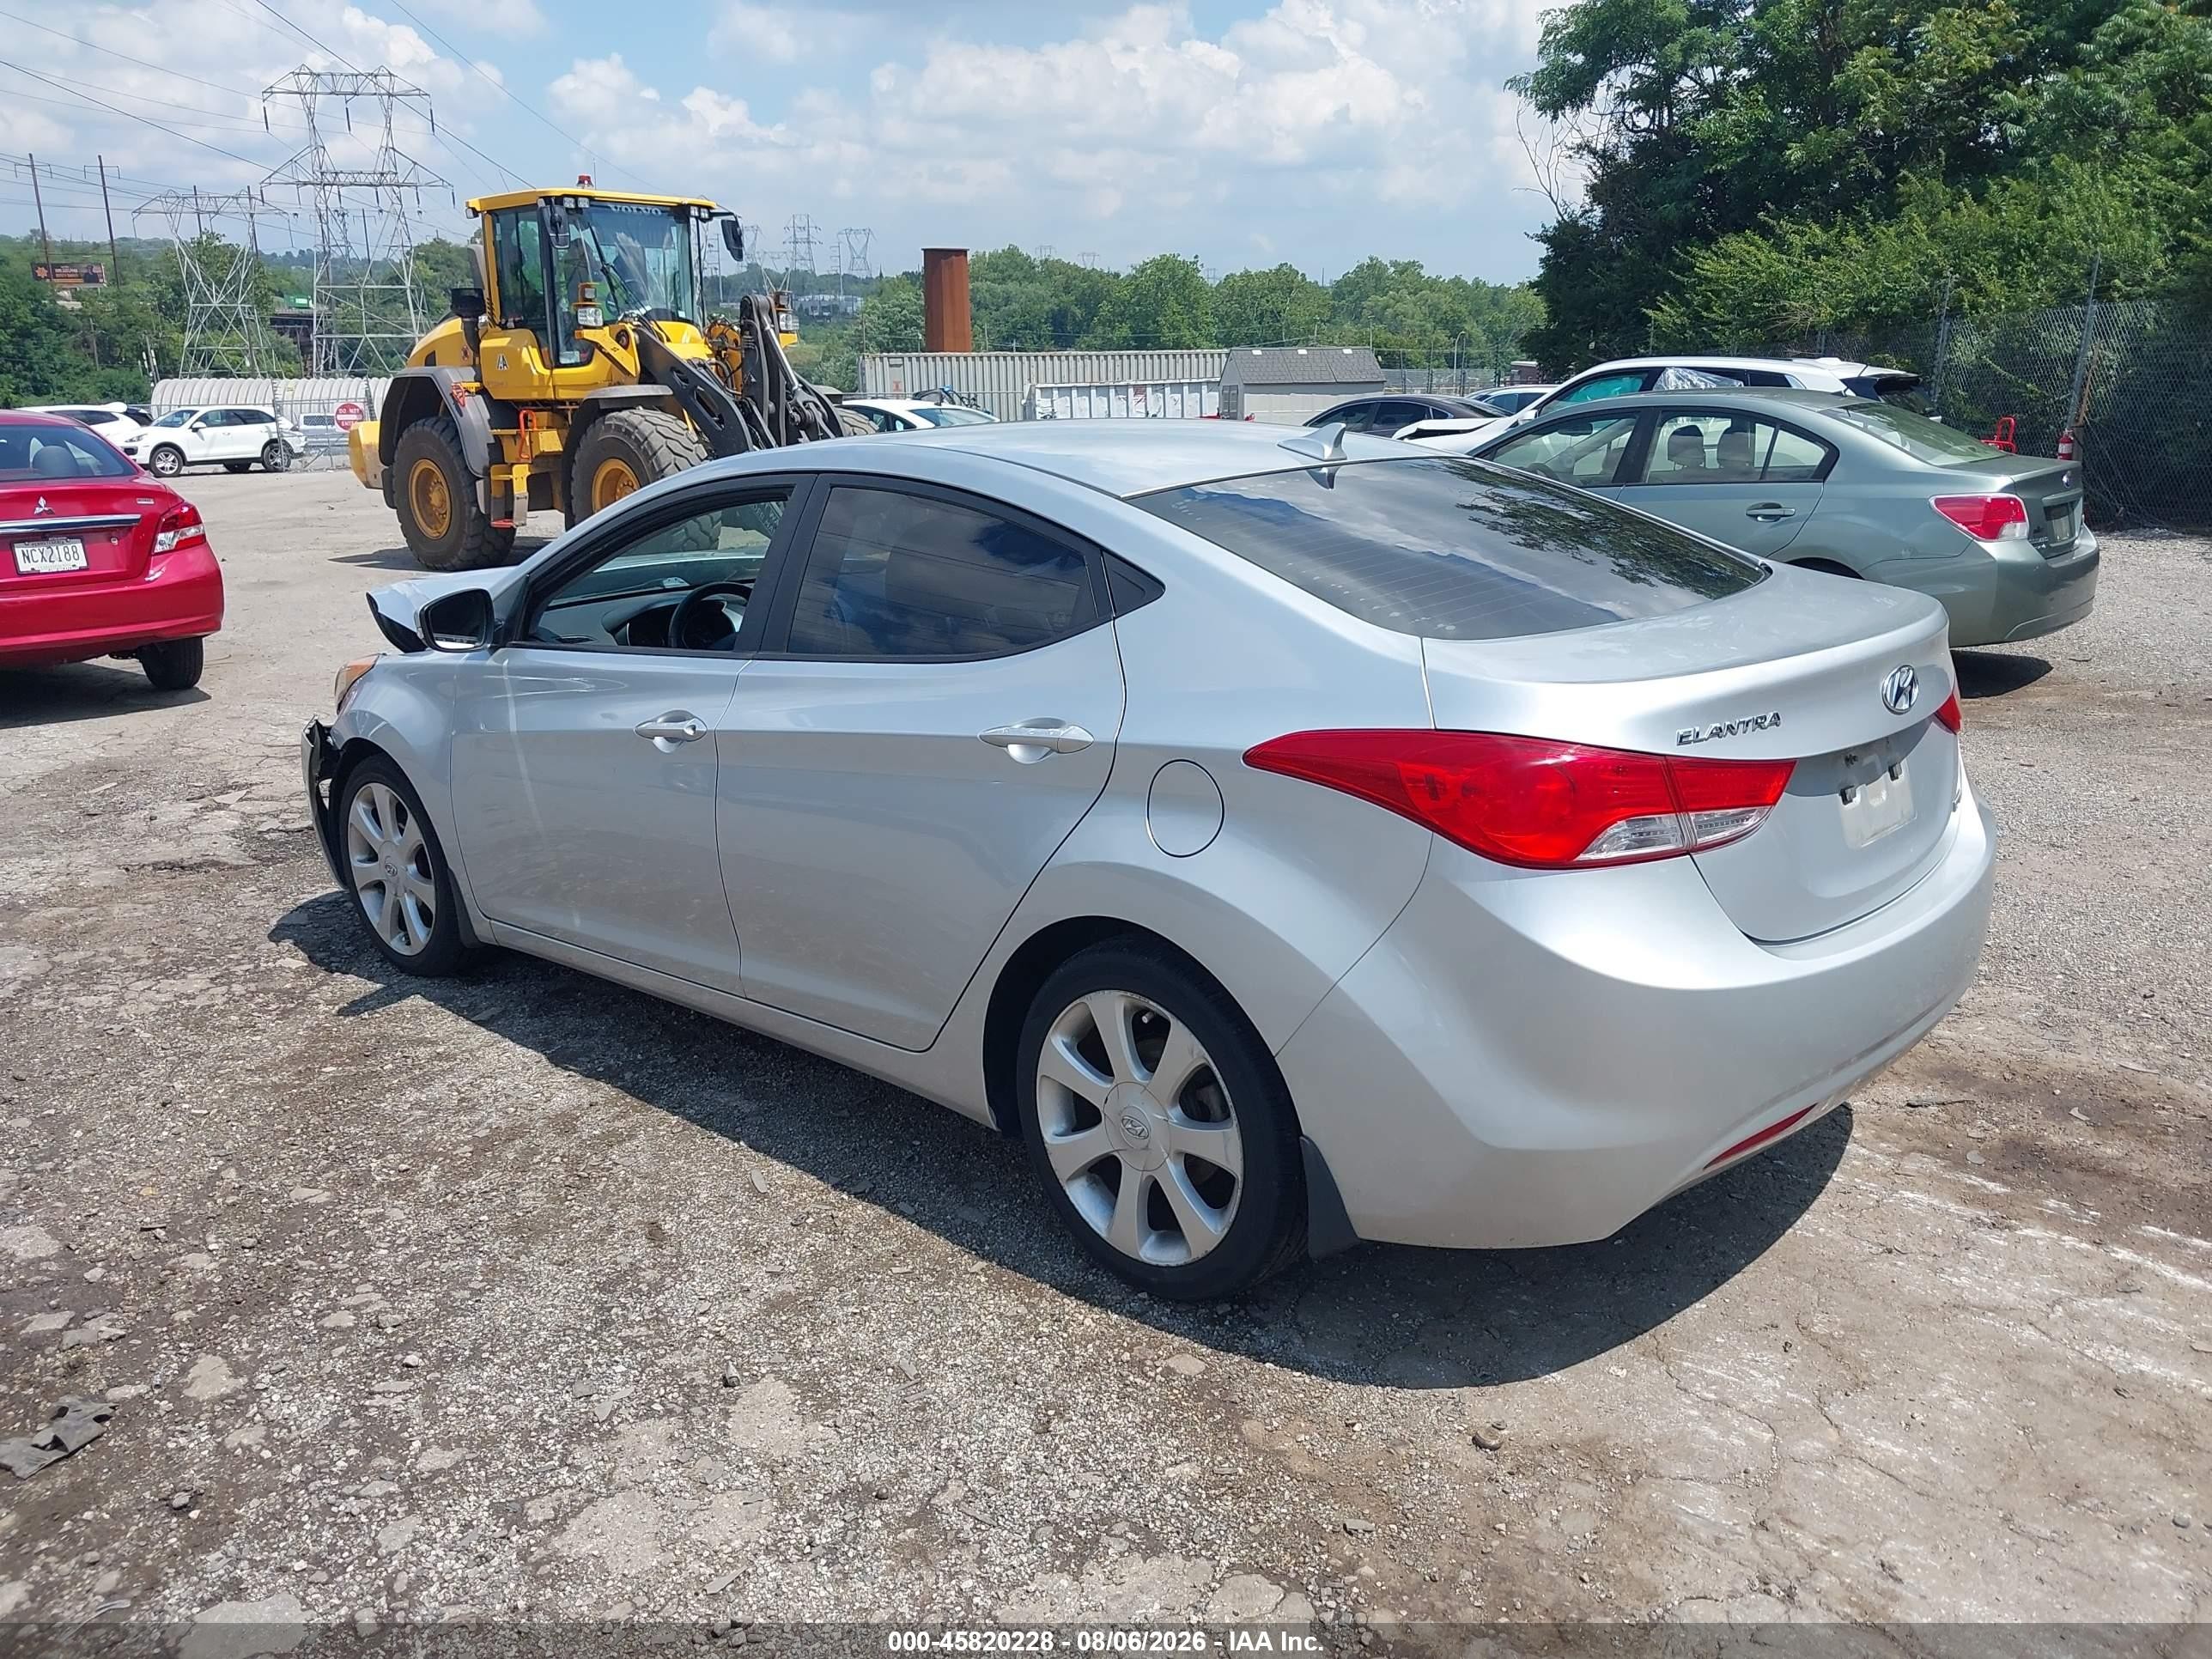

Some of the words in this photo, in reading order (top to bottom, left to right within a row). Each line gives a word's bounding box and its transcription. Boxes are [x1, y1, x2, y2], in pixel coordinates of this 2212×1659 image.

[608, 204, 661, 216] VOLVO
[21, 544, 80, 564] NCX2188
[1676, 710, 1781, 746] ELANTRA
